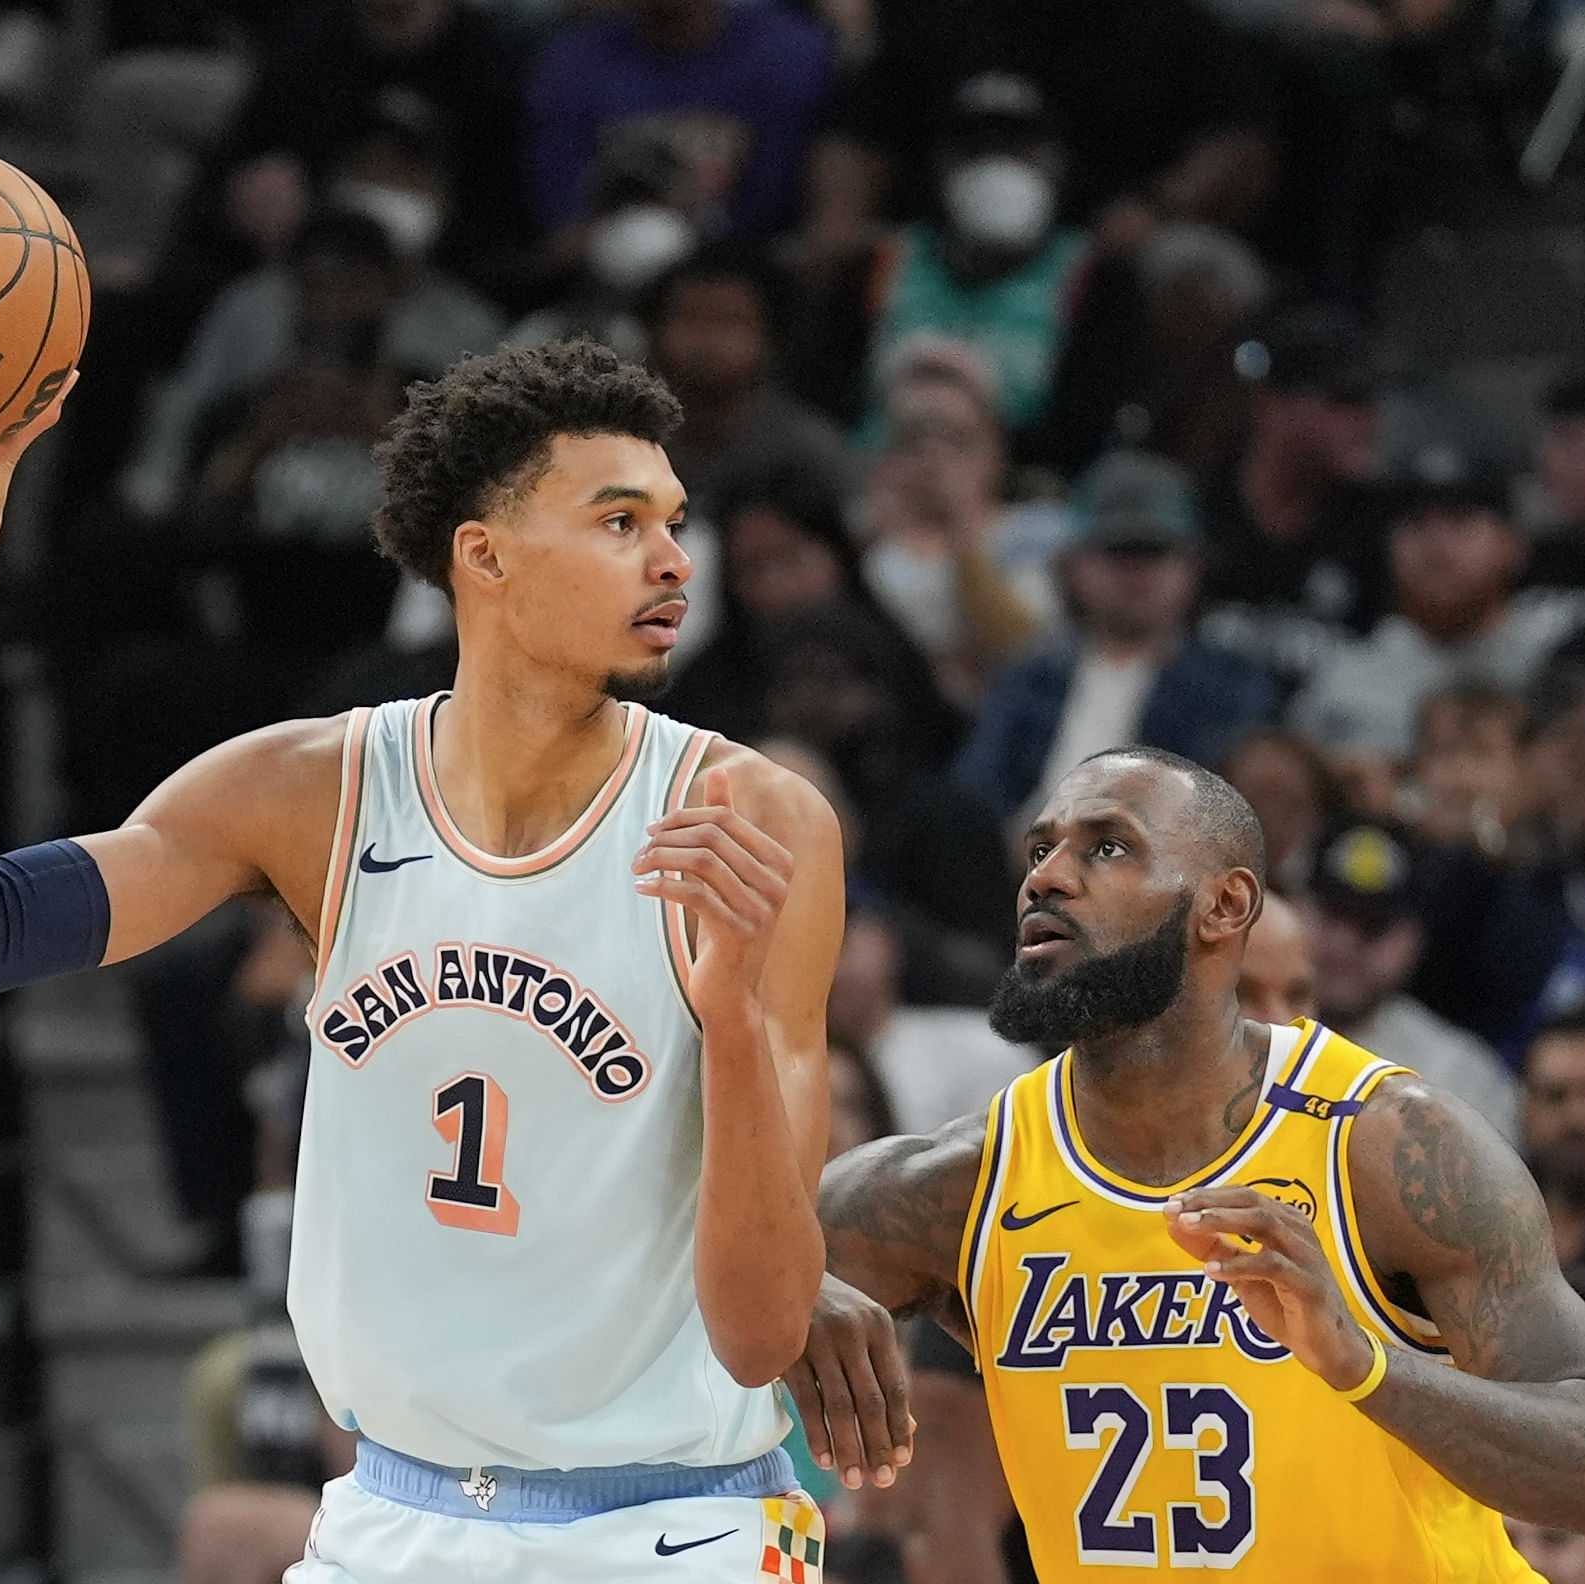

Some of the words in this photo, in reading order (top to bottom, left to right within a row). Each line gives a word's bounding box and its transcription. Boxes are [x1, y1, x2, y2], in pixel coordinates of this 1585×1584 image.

[321, 955, 430, 1063] SAN
[437, 948, 645, 1096] ANTONIO
[425, 1071, 512, 1224] 1
[1304, 1096, 1332, 1119] 44
[996, 1252, 1295, 1371] LAKER
[1059, 1383, 1257, 1570] 23
